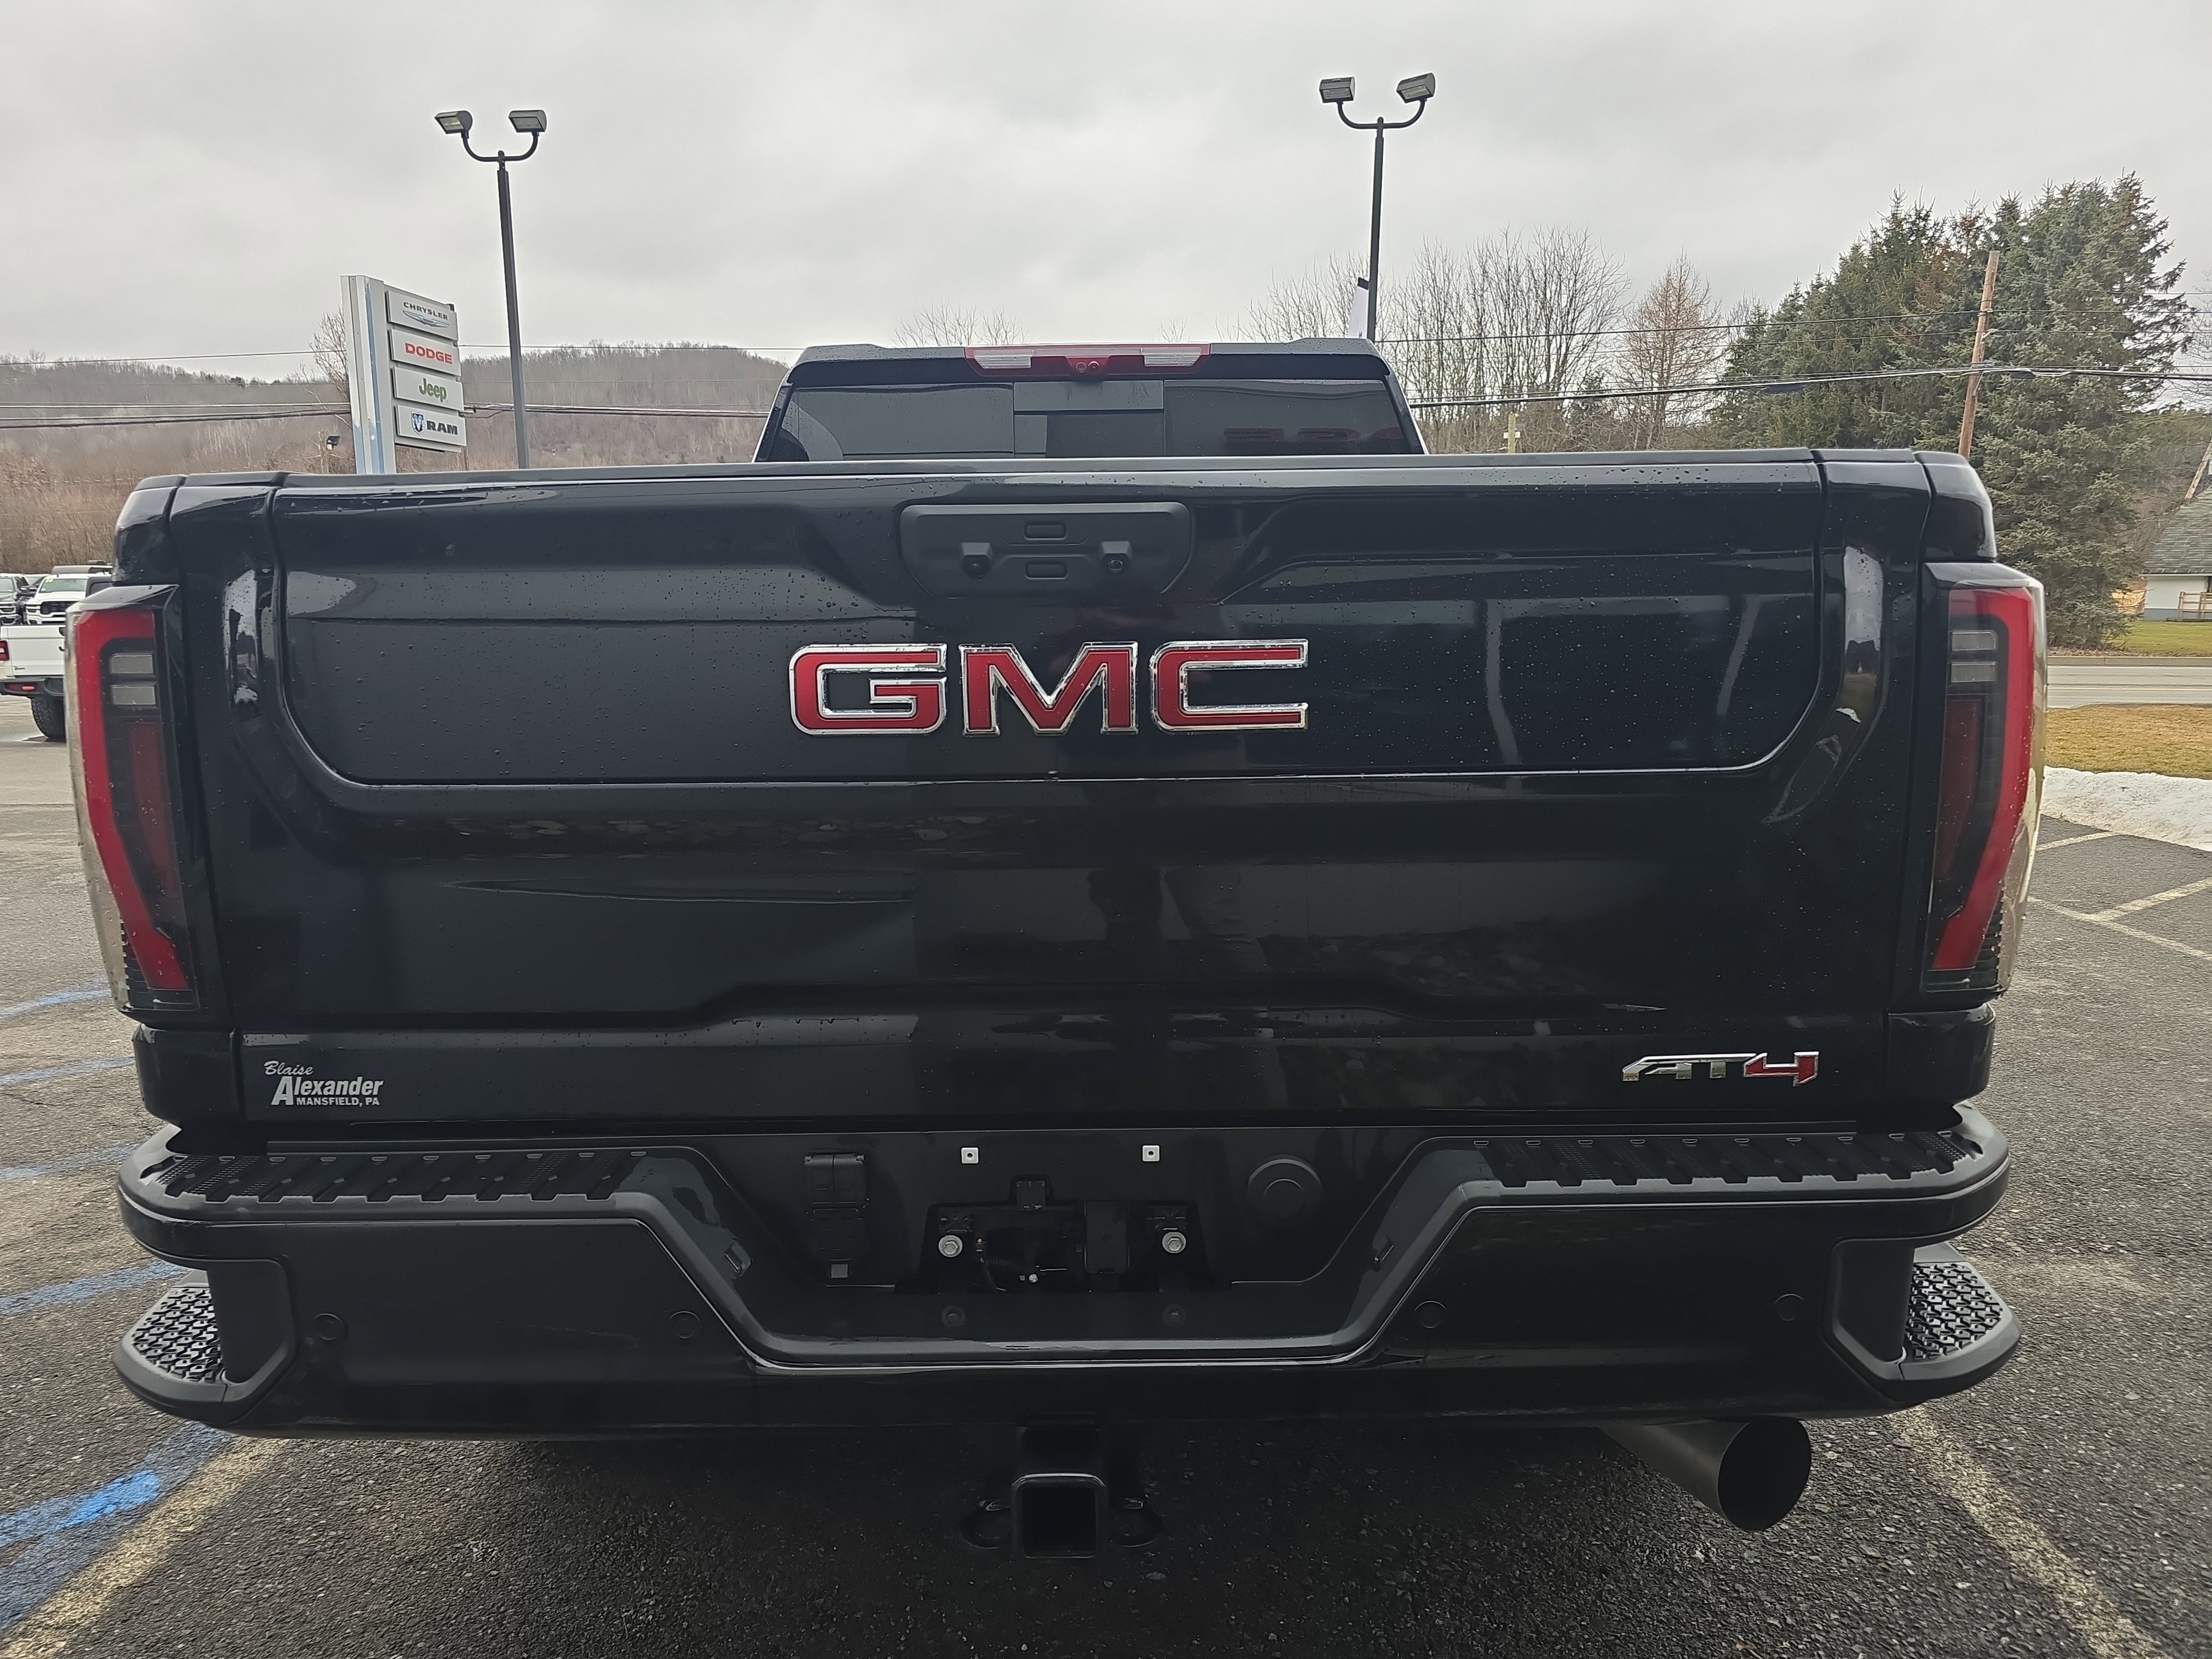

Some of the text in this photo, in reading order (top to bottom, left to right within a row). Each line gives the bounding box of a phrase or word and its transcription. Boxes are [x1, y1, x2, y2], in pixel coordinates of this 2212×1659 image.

[403, 302, 448, 320] CHRYSLER
[405, 343, 453, 364] DODGE
[419, 378, 447, 402] Jeep
[426, 420, 458, 435] RAM
[788, 638, 1308, 736] GMC
[263, 1060, 314, 1076] Blaise
[1622, 1051, 1819, 1086] AT4
[271, 1076, 384, 1105] Alexander
[297, 1097, 380, 1107] MANSFIELD, PA
